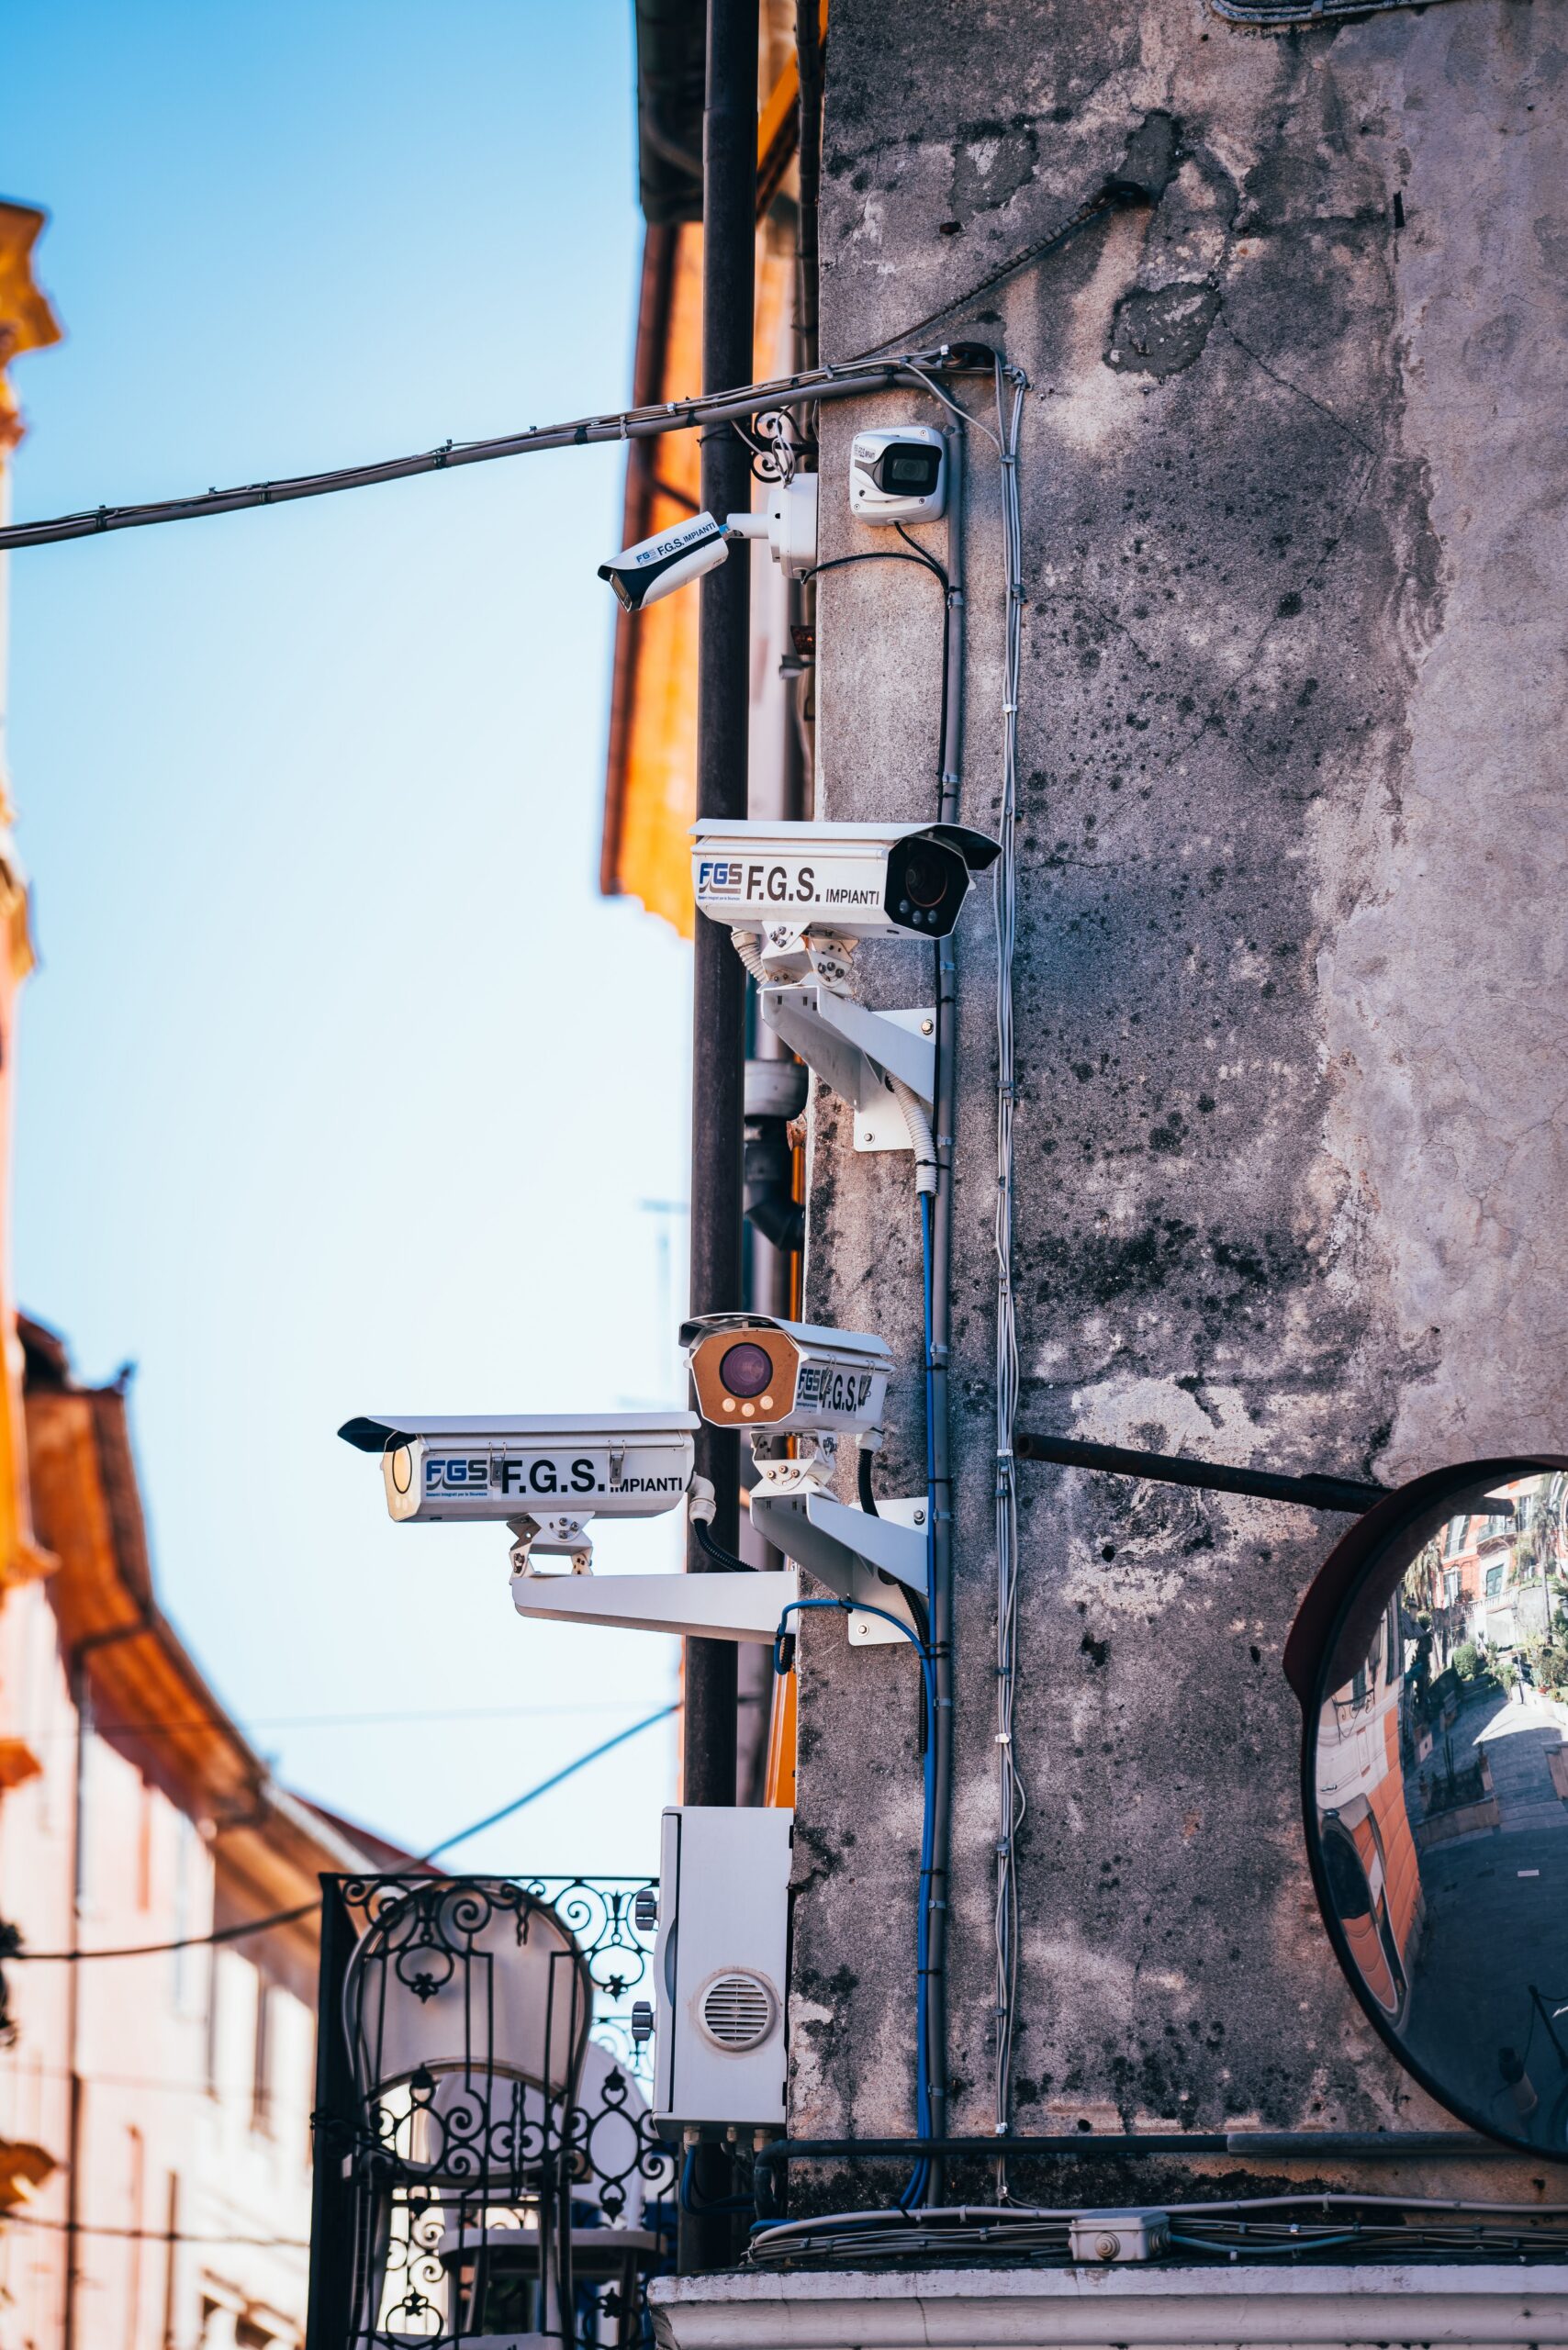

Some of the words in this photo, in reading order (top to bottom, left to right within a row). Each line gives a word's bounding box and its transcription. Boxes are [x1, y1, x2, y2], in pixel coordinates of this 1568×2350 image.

[636, 549, 656, 563] FGS
[657, 539, 684, 556] F.G.S.
[684, 522, 716, 543] IMPIANTI
[699, 863, 743, 885] FGS
[746, 866, 821, 902] F.G.S.
[825, 889, 879, 905] IMPIANTI
[798, 1368, 821, 1391] FGS
[426, 1460, 487, 1482] FGS
[502, 1459, 605, 1494] F.G.S.
